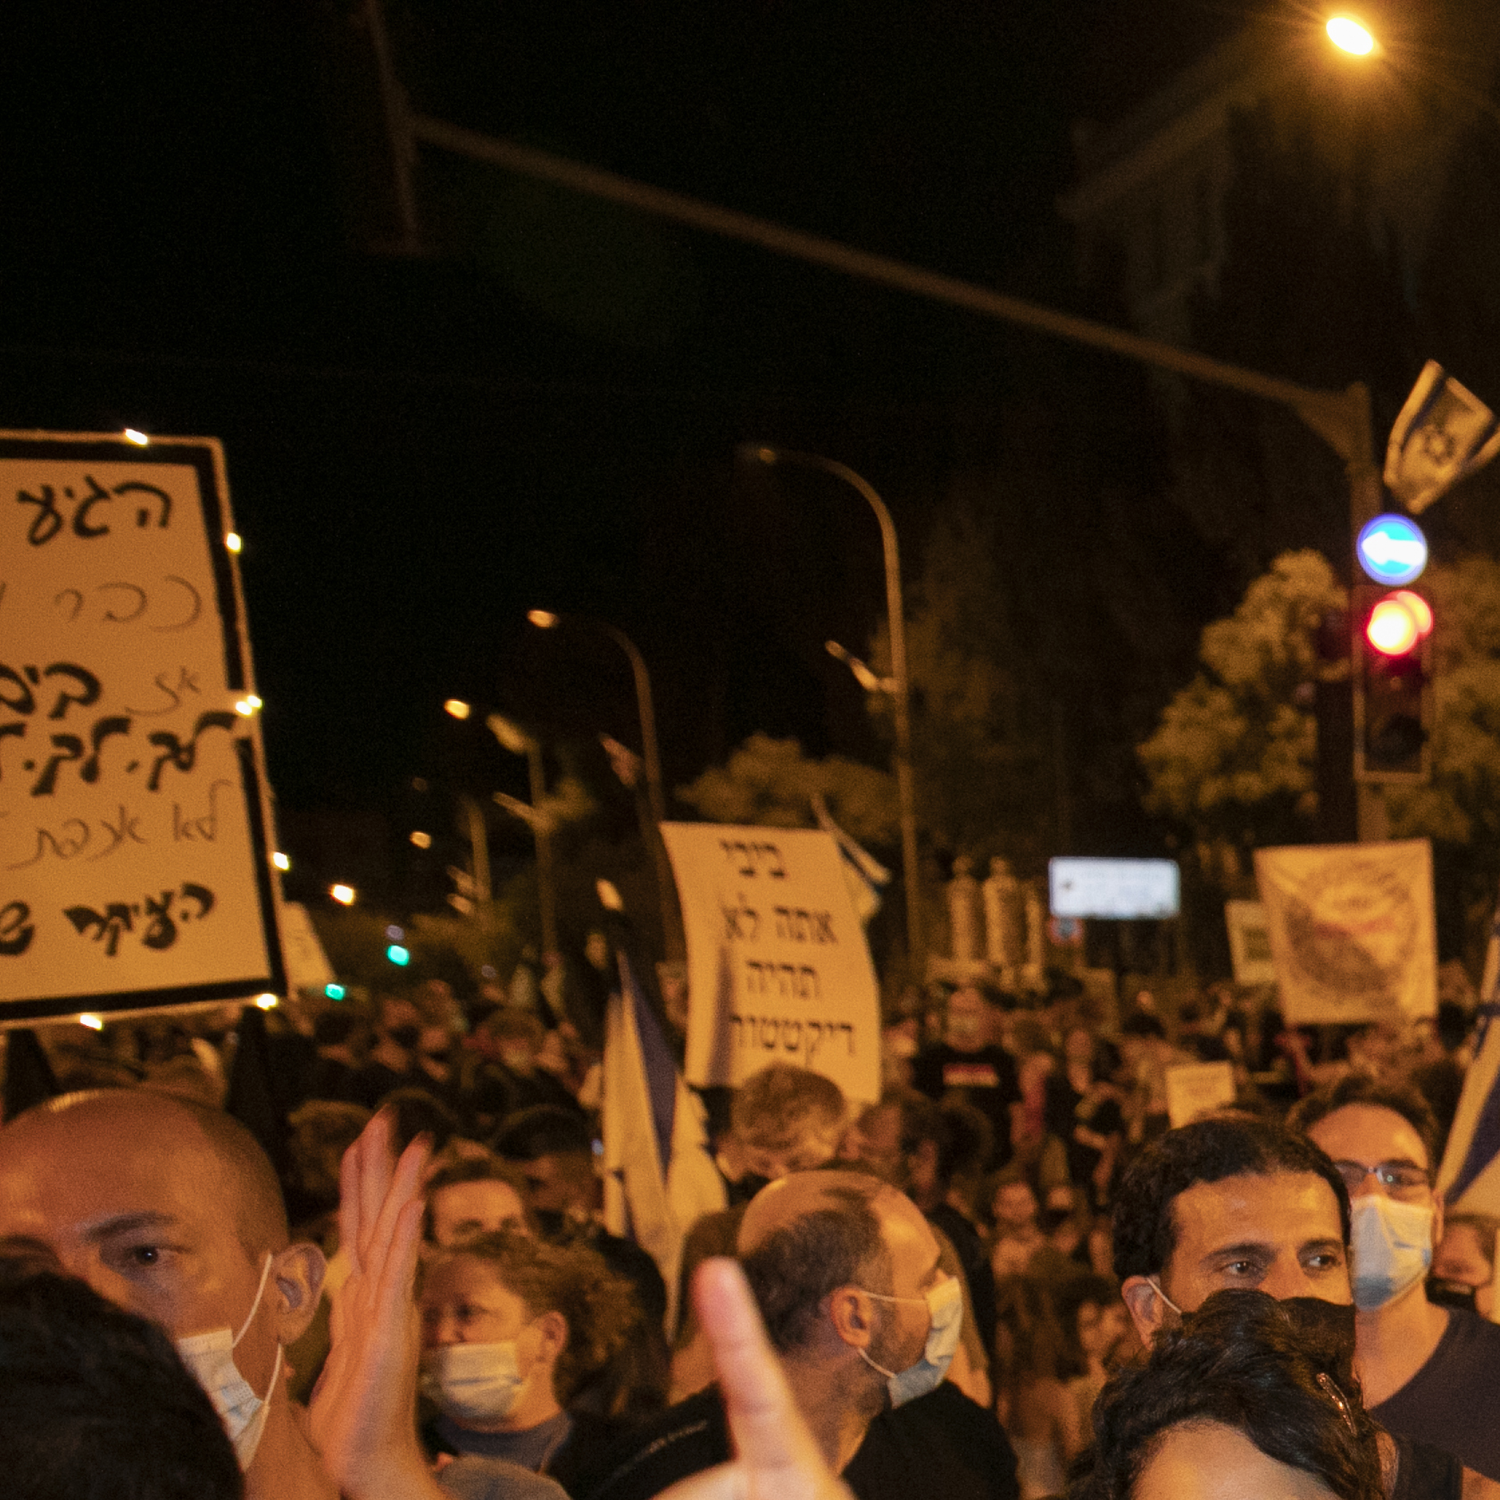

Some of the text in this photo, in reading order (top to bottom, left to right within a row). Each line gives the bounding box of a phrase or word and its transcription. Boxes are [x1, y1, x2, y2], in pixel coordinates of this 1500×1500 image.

[16, 475, 172, 546] הגיע
[720, 838, 786, 879] ביבי
[721, 891, 838, 945] אתה לא
[746, 958, 820, 999] תהיה
[730, 1012, 854, 1069] דיקטטור
